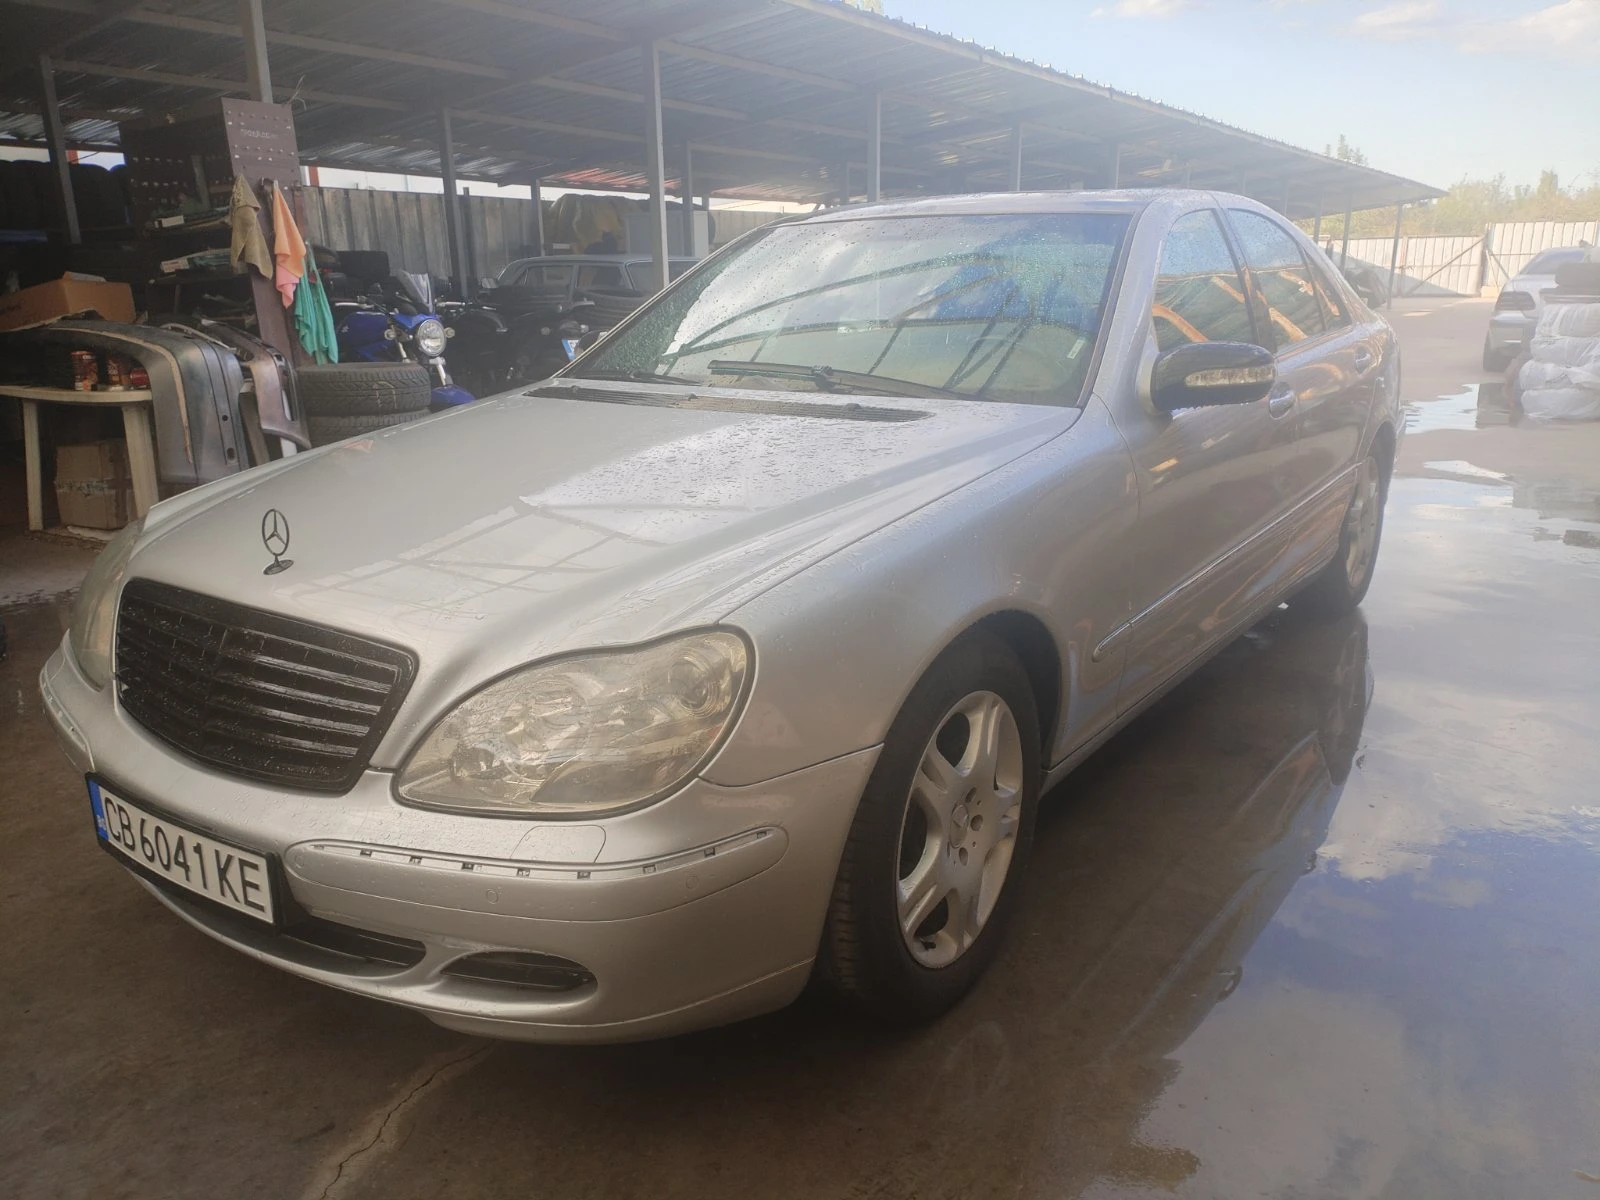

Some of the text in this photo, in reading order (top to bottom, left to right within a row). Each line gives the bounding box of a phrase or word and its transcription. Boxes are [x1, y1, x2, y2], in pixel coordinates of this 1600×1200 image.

[104, 796, 265, 914] CB 6041 KE
